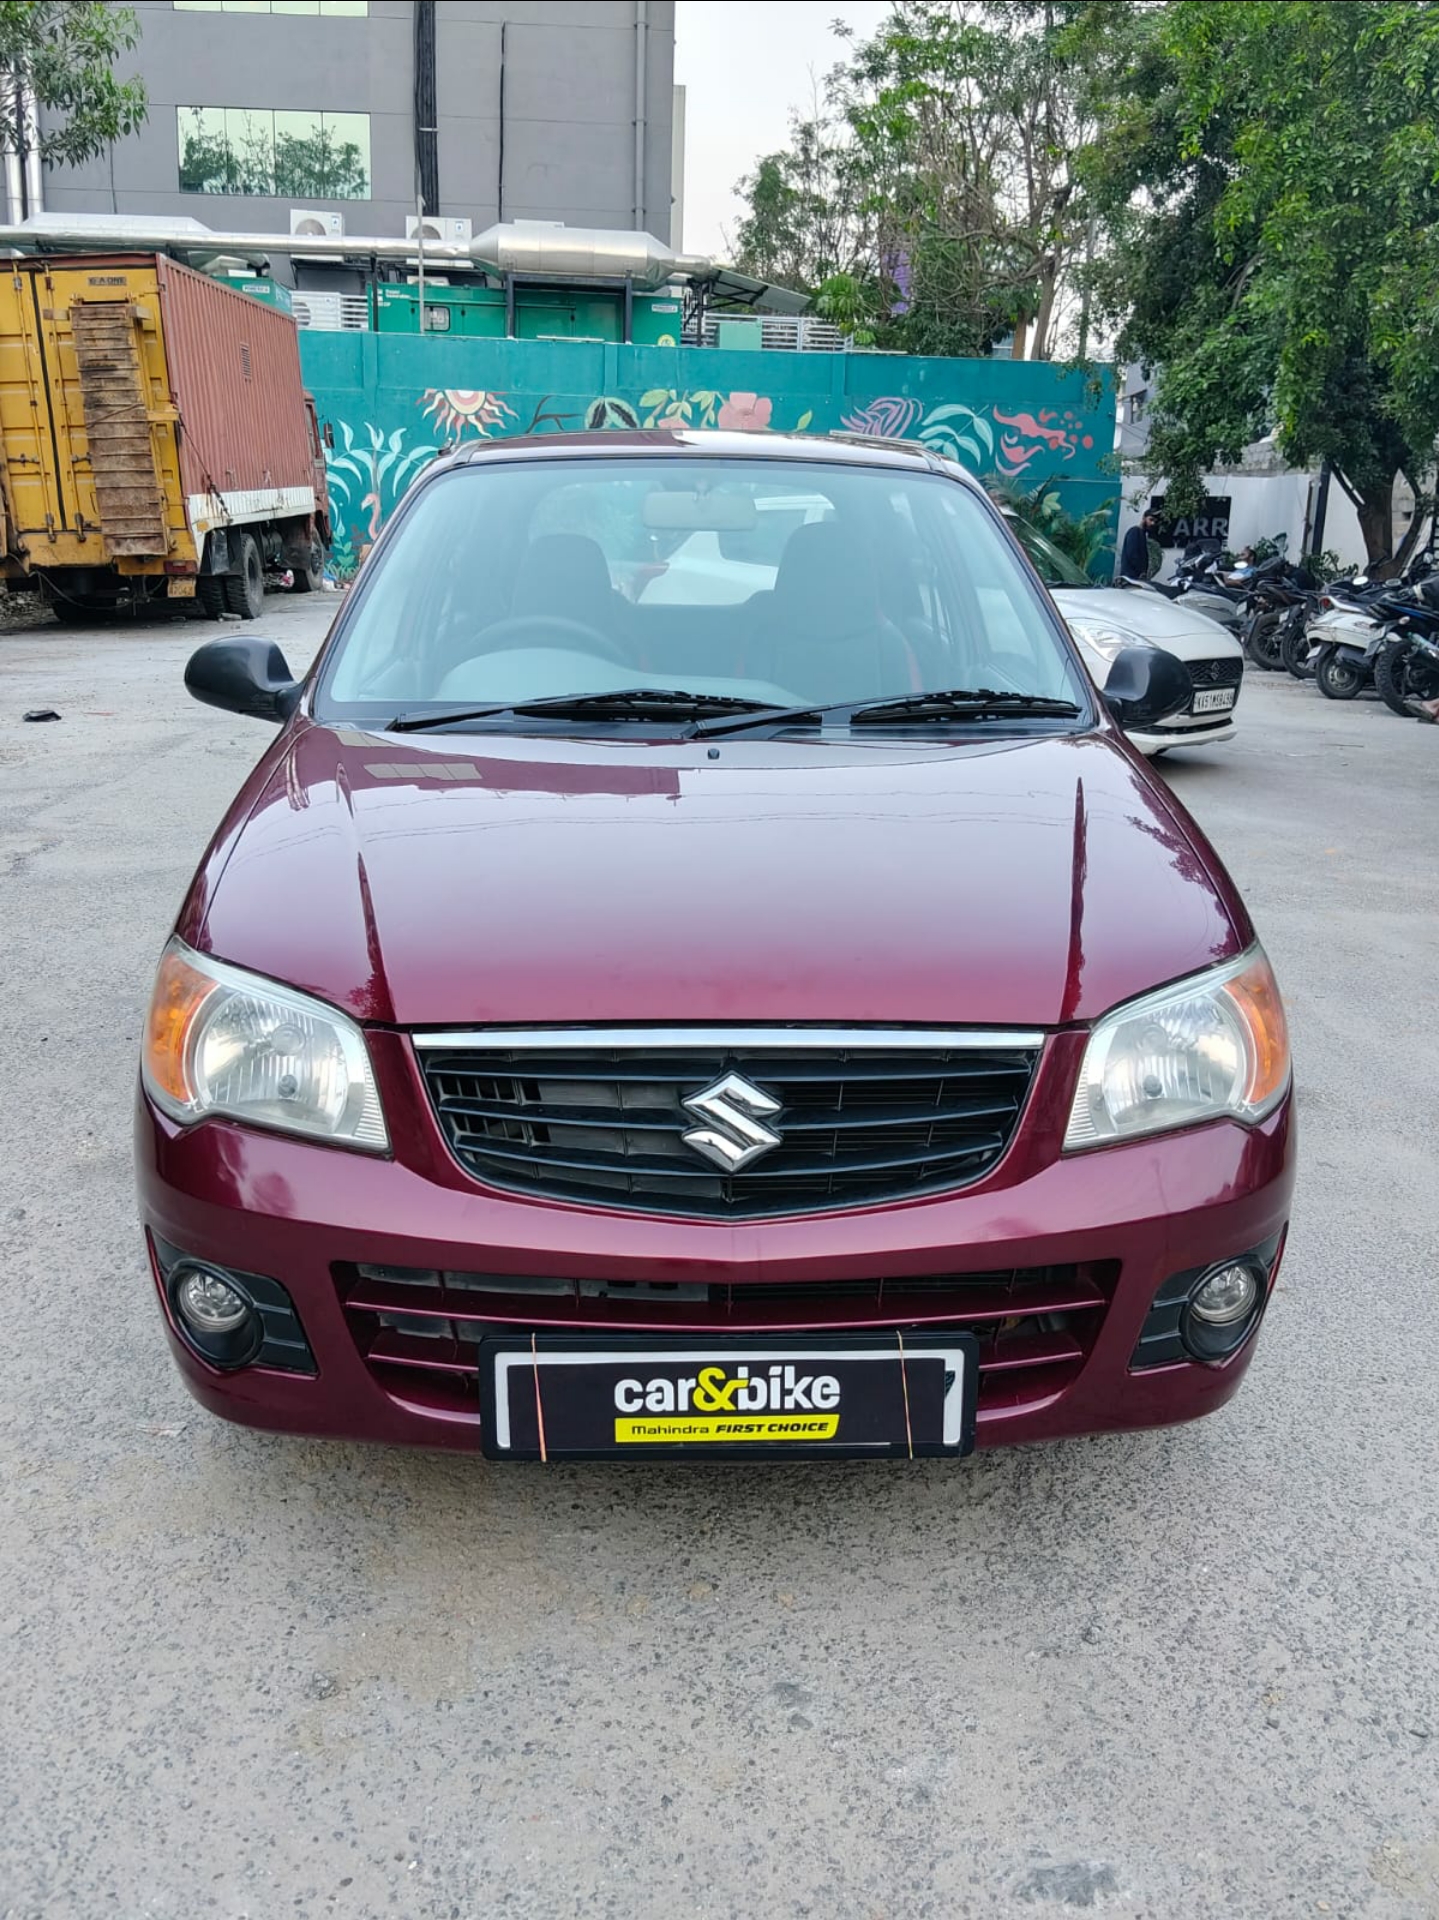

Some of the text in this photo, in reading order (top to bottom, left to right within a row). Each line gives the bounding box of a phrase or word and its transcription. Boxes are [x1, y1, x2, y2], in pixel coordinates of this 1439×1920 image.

[614, 1365, 840, 1412] car&bike
[632, 1422, 829, 1435] Mahindra FIRST CHOICE
